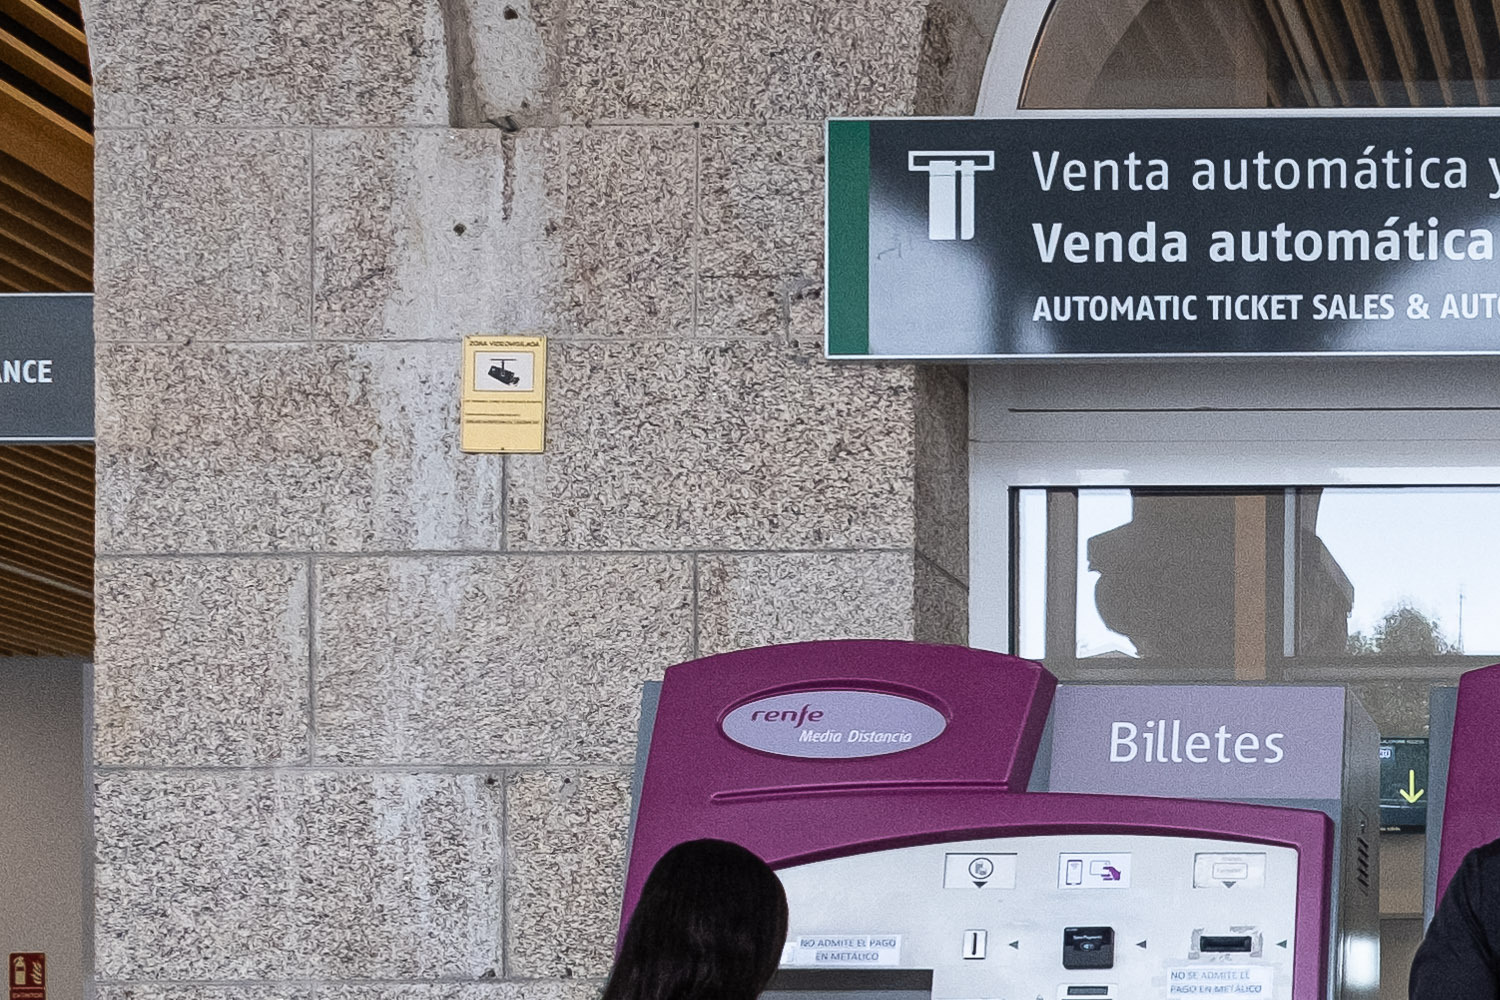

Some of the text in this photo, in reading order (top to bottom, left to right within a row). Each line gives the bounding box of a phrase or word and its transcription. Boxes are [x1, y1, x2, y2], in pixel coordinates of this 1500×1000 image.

[1032, 151, 1170, 192] Venta
[1192, 145, 1467, 191] automática
[1032, 221, 1188, 263] Venda
[1209, 216, 1494, 263] automática
[1032, 295, 1197, 322] AUTOMATIC
[1206, 294, 1303, 321] TICKET
[1312, 294, 1395, 321] SALES
[1407, 293, 1430, 320] &
[751, 704, 824, 728] renfe
[799, 730, 912, 743] Media Distancia
[1109, 720, 1285, 764] Billetes
[800, 939, 815, 948] NO
[818, 939, 853, 948] ADMITE
[869, 939, 897, 948] PAGO
[816, 952, 828, 961] EN
[1171, 971, 1185, 980] NO
[1201, 971, 1237, 980] ADMITE
[1171, 984, 1197, 993] PAGO
